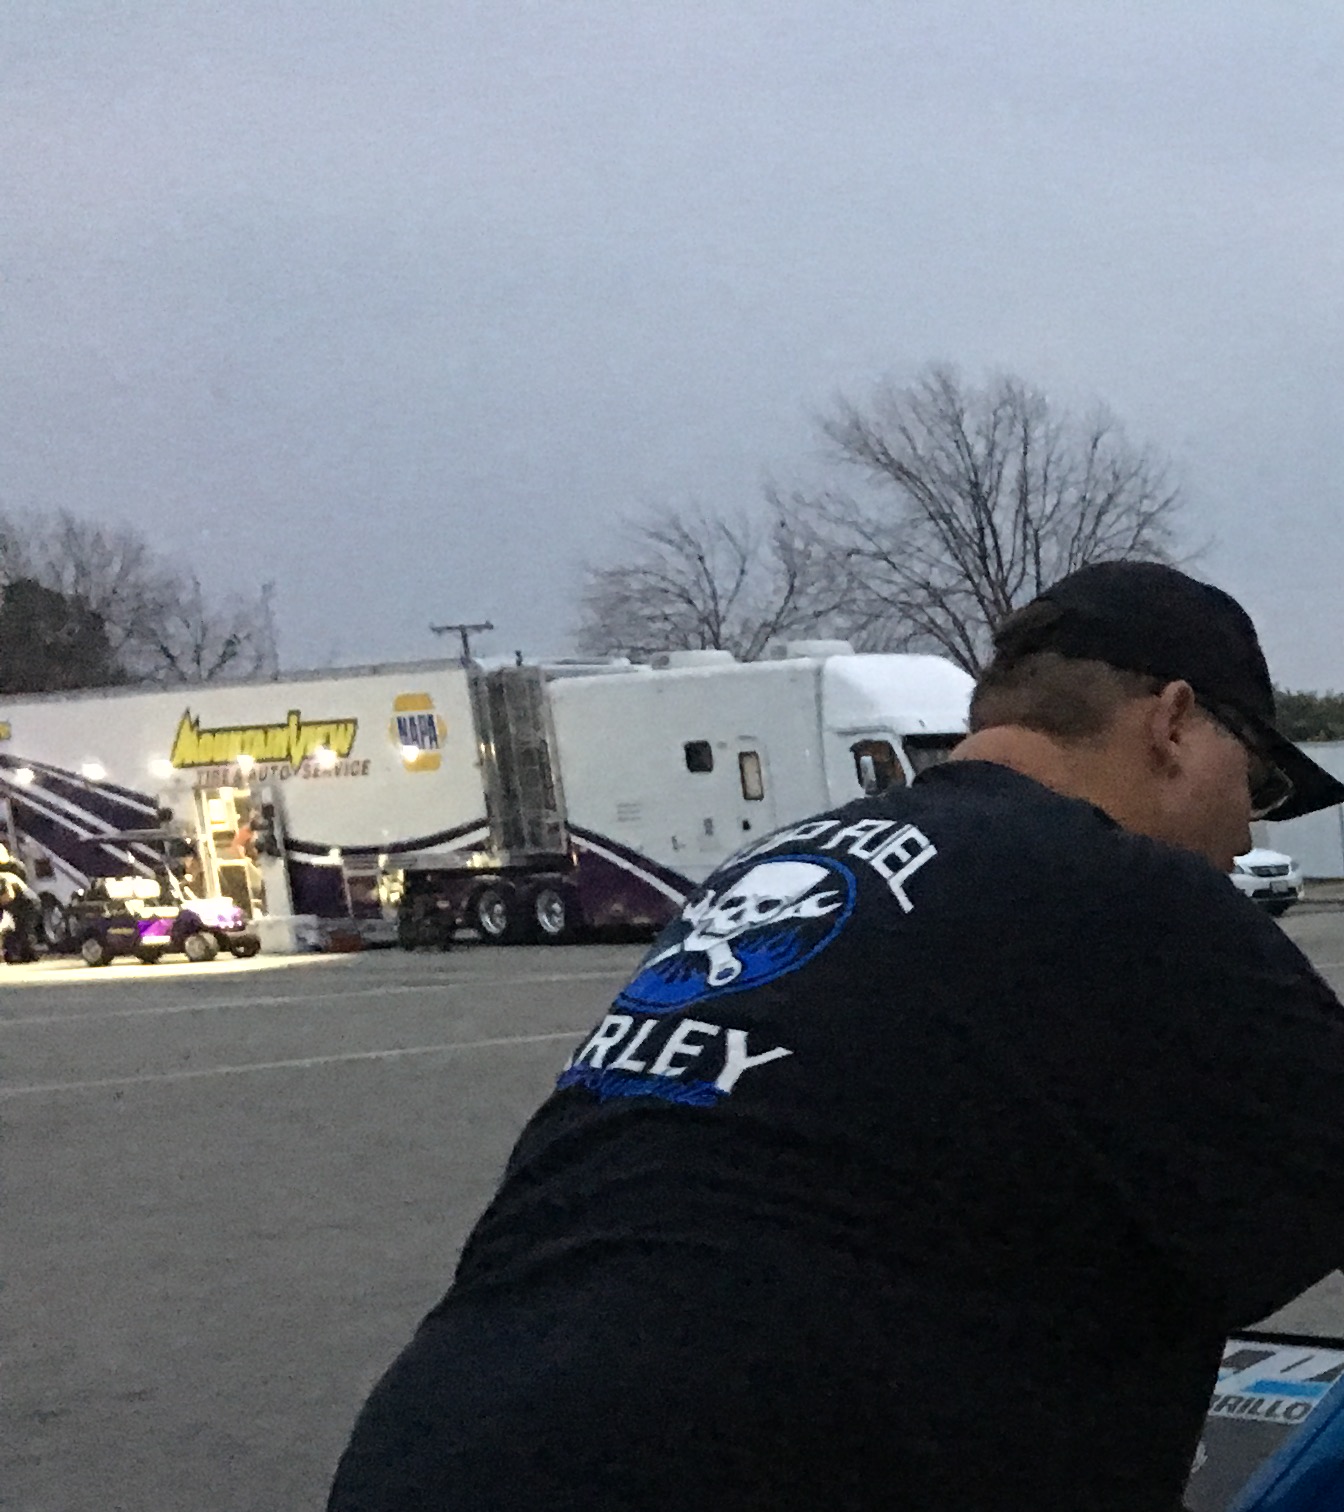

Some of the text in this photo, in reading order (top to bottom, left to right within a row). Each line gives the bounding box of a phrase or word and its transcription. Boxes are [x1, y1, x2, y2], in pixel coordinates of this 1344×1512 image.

[395, 713, 439, 751] NAPA
[564, 1014, 794, 1095] RLEY
[1211, 1394, 1313, 1421] RILLO
